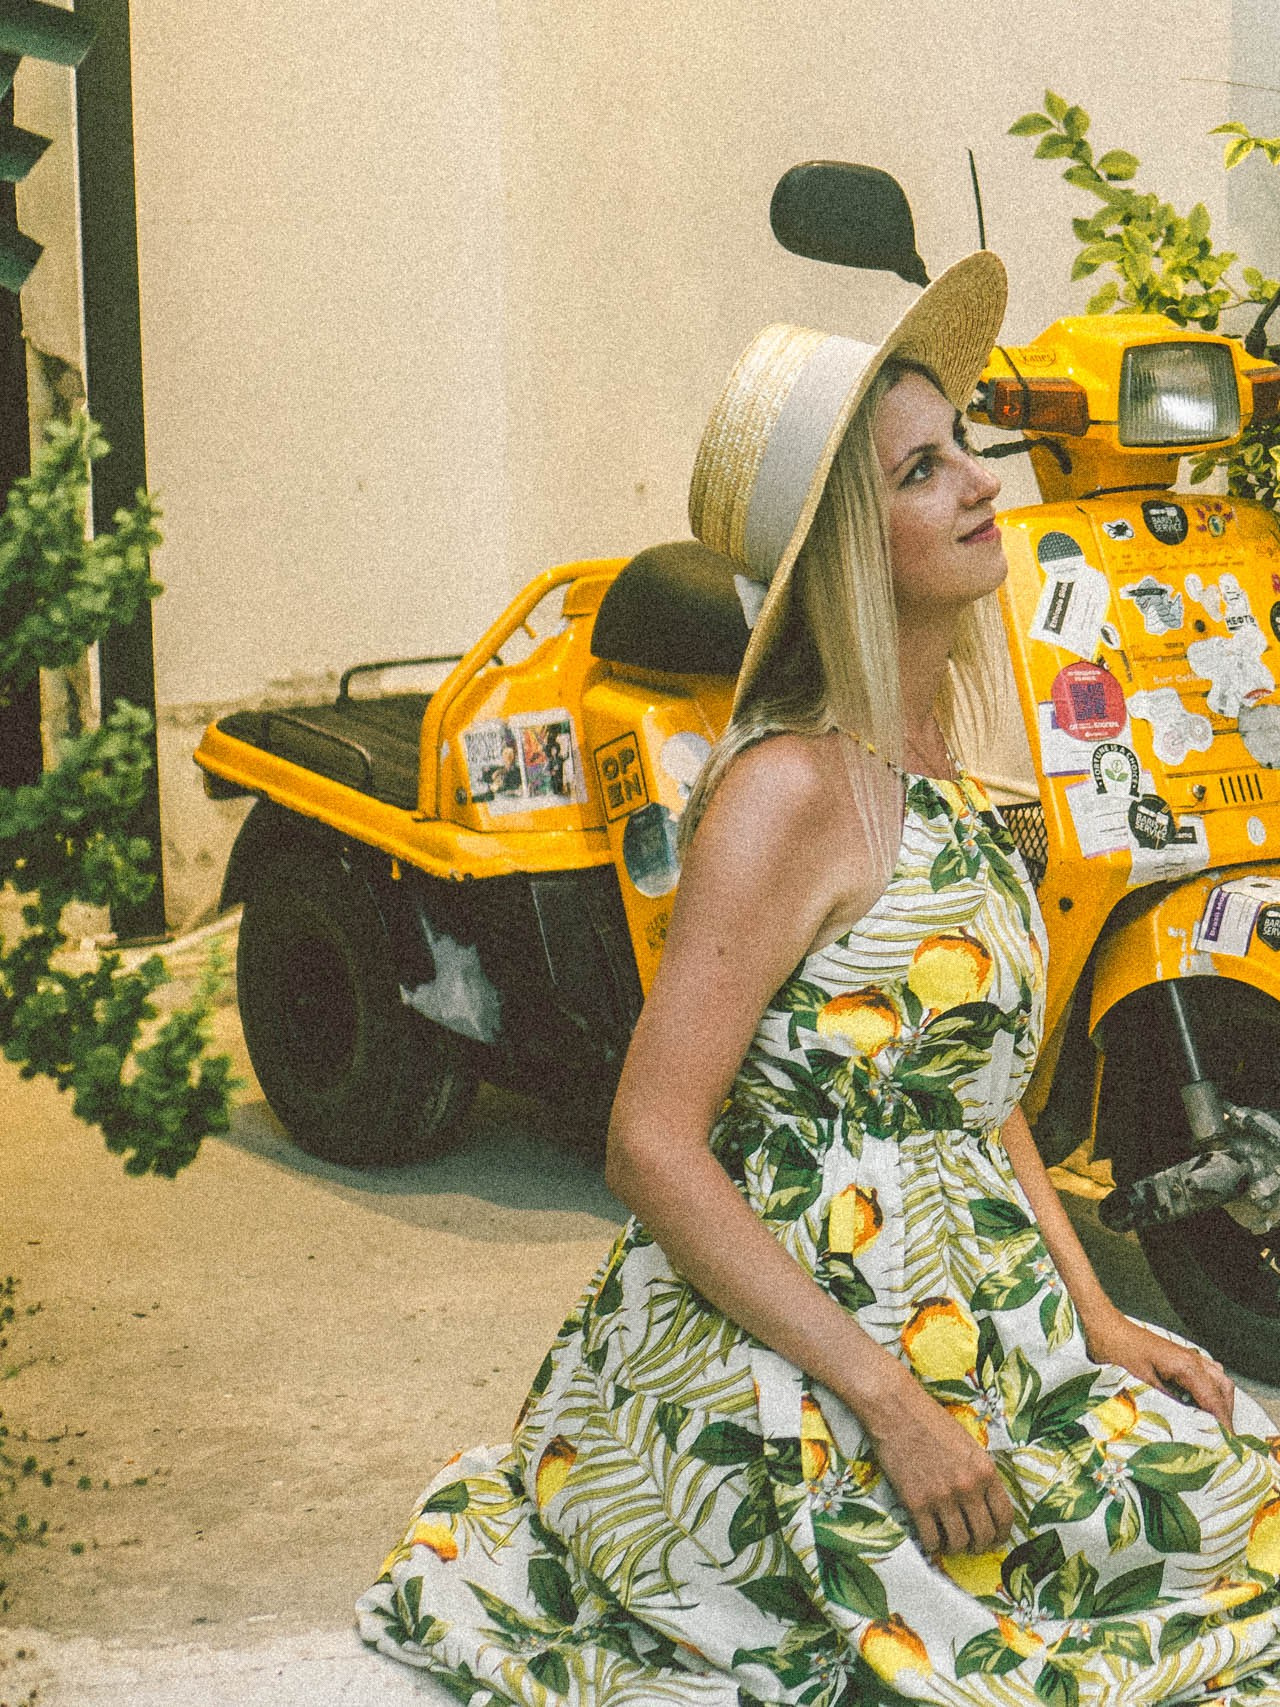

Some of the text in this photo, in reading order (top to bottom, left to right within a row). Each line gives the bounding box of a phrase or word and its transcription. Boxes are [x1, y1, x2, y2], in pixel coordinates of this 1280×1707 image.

[1153, 523, 1184, 533] SERVICE
[1226, 614, 1255, 626] НЕФТЬ
[1093, 744, 1110, 781] FORTUNE
[1110, 744, 1119, 752] IS
[1126, 752, 1139, 785] CHOICE
[1134, 821, 1167, 842] SERVICE
